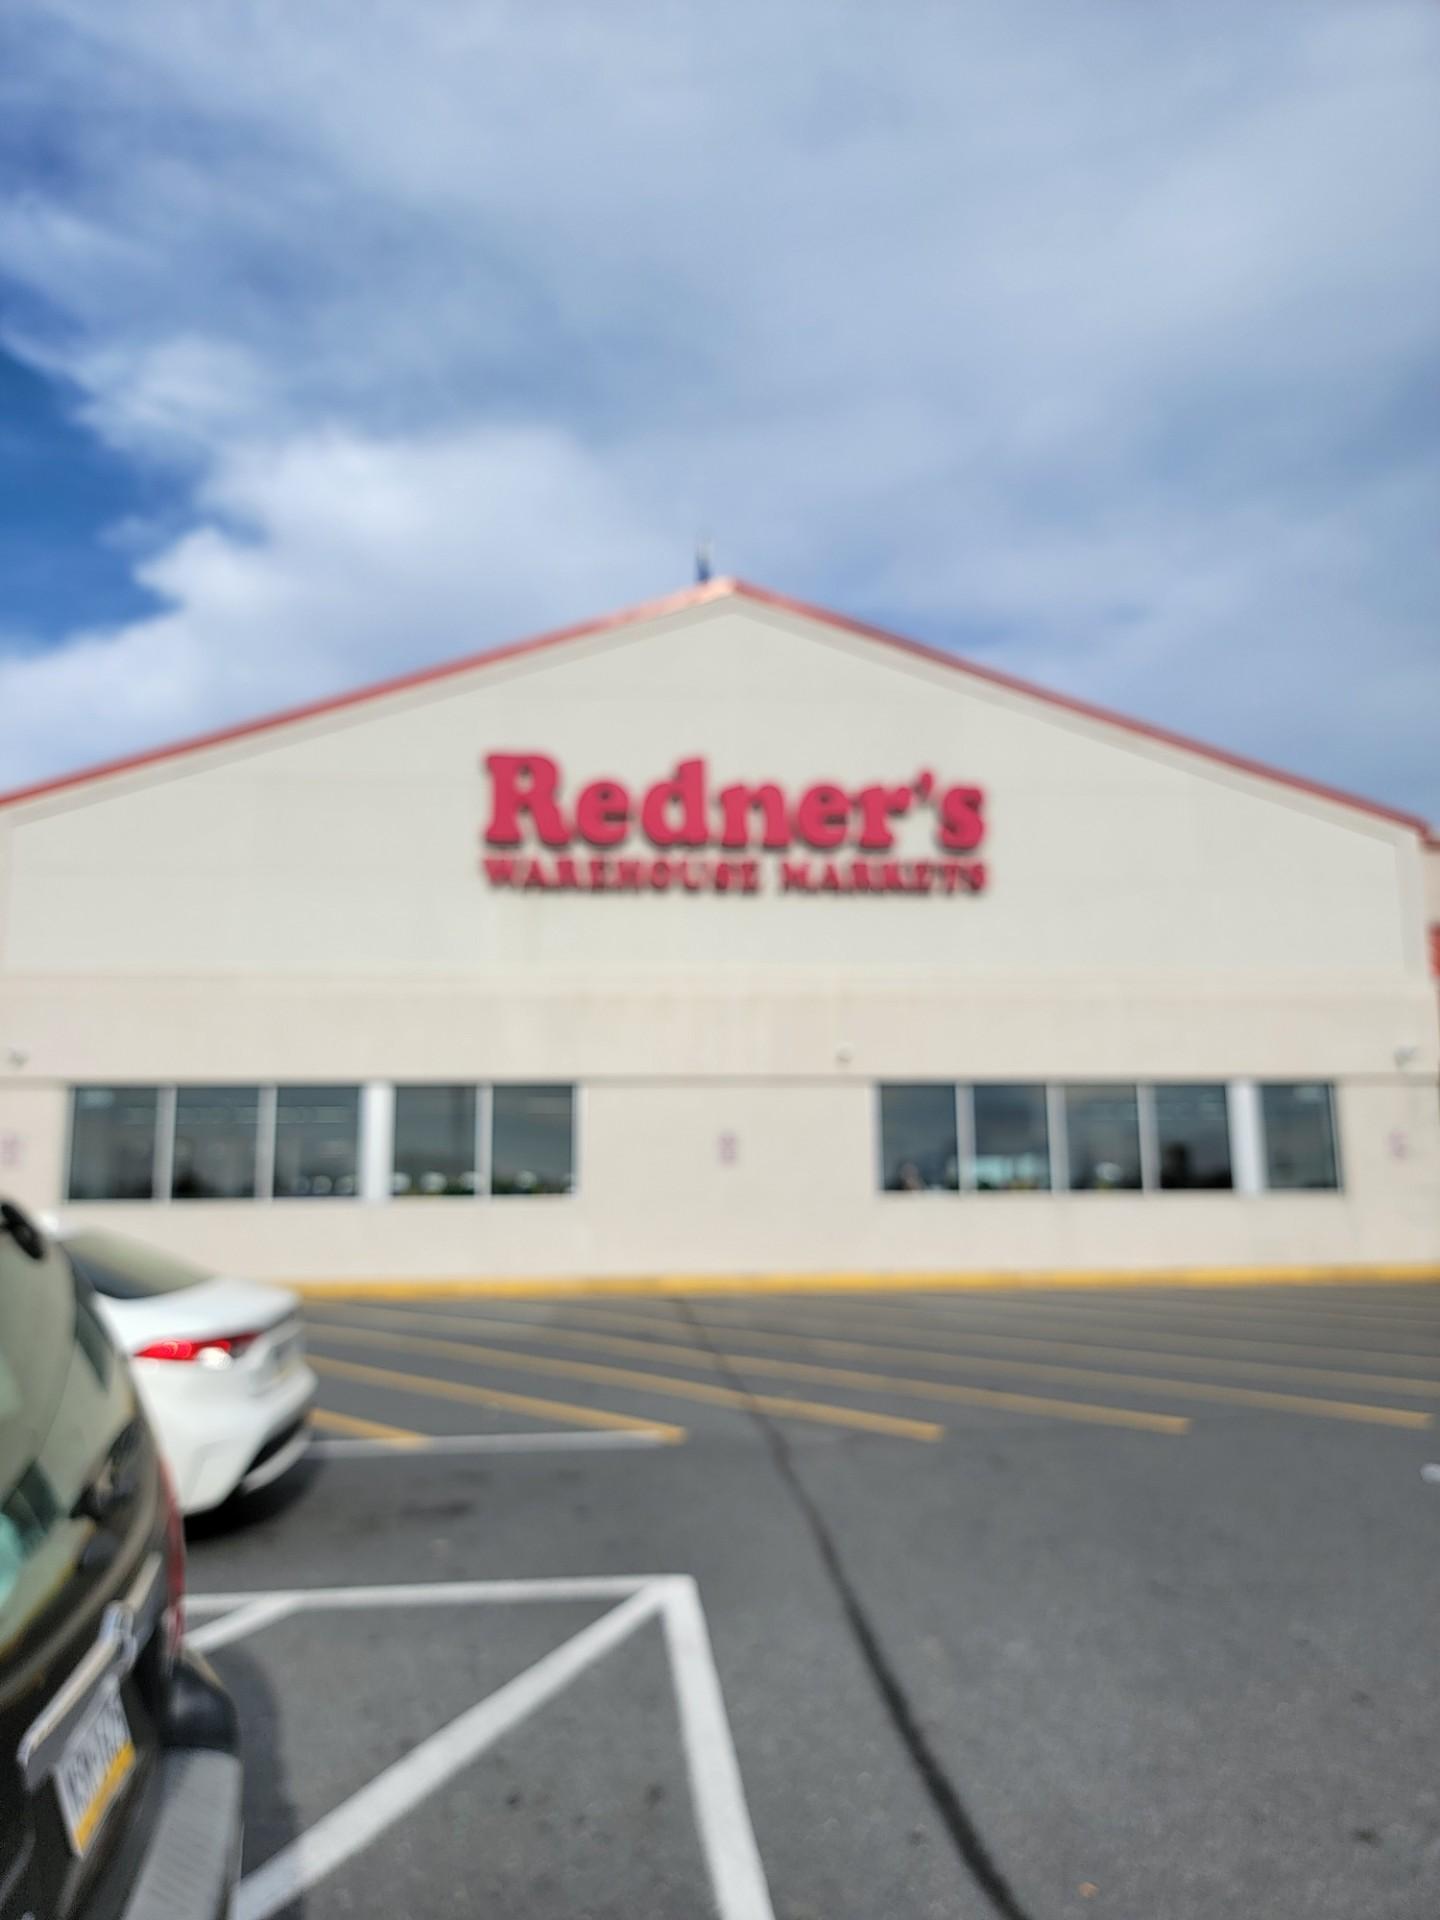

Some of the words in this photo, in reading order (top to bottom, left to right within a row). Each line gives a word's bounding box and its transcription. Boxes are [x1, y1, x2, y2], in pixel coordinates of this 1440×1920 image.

[483, 750, 988, 851] Redner's
[482, 855, 758, 893] WAREHOUSE
[780, 857, 988, 894] MARKETS
